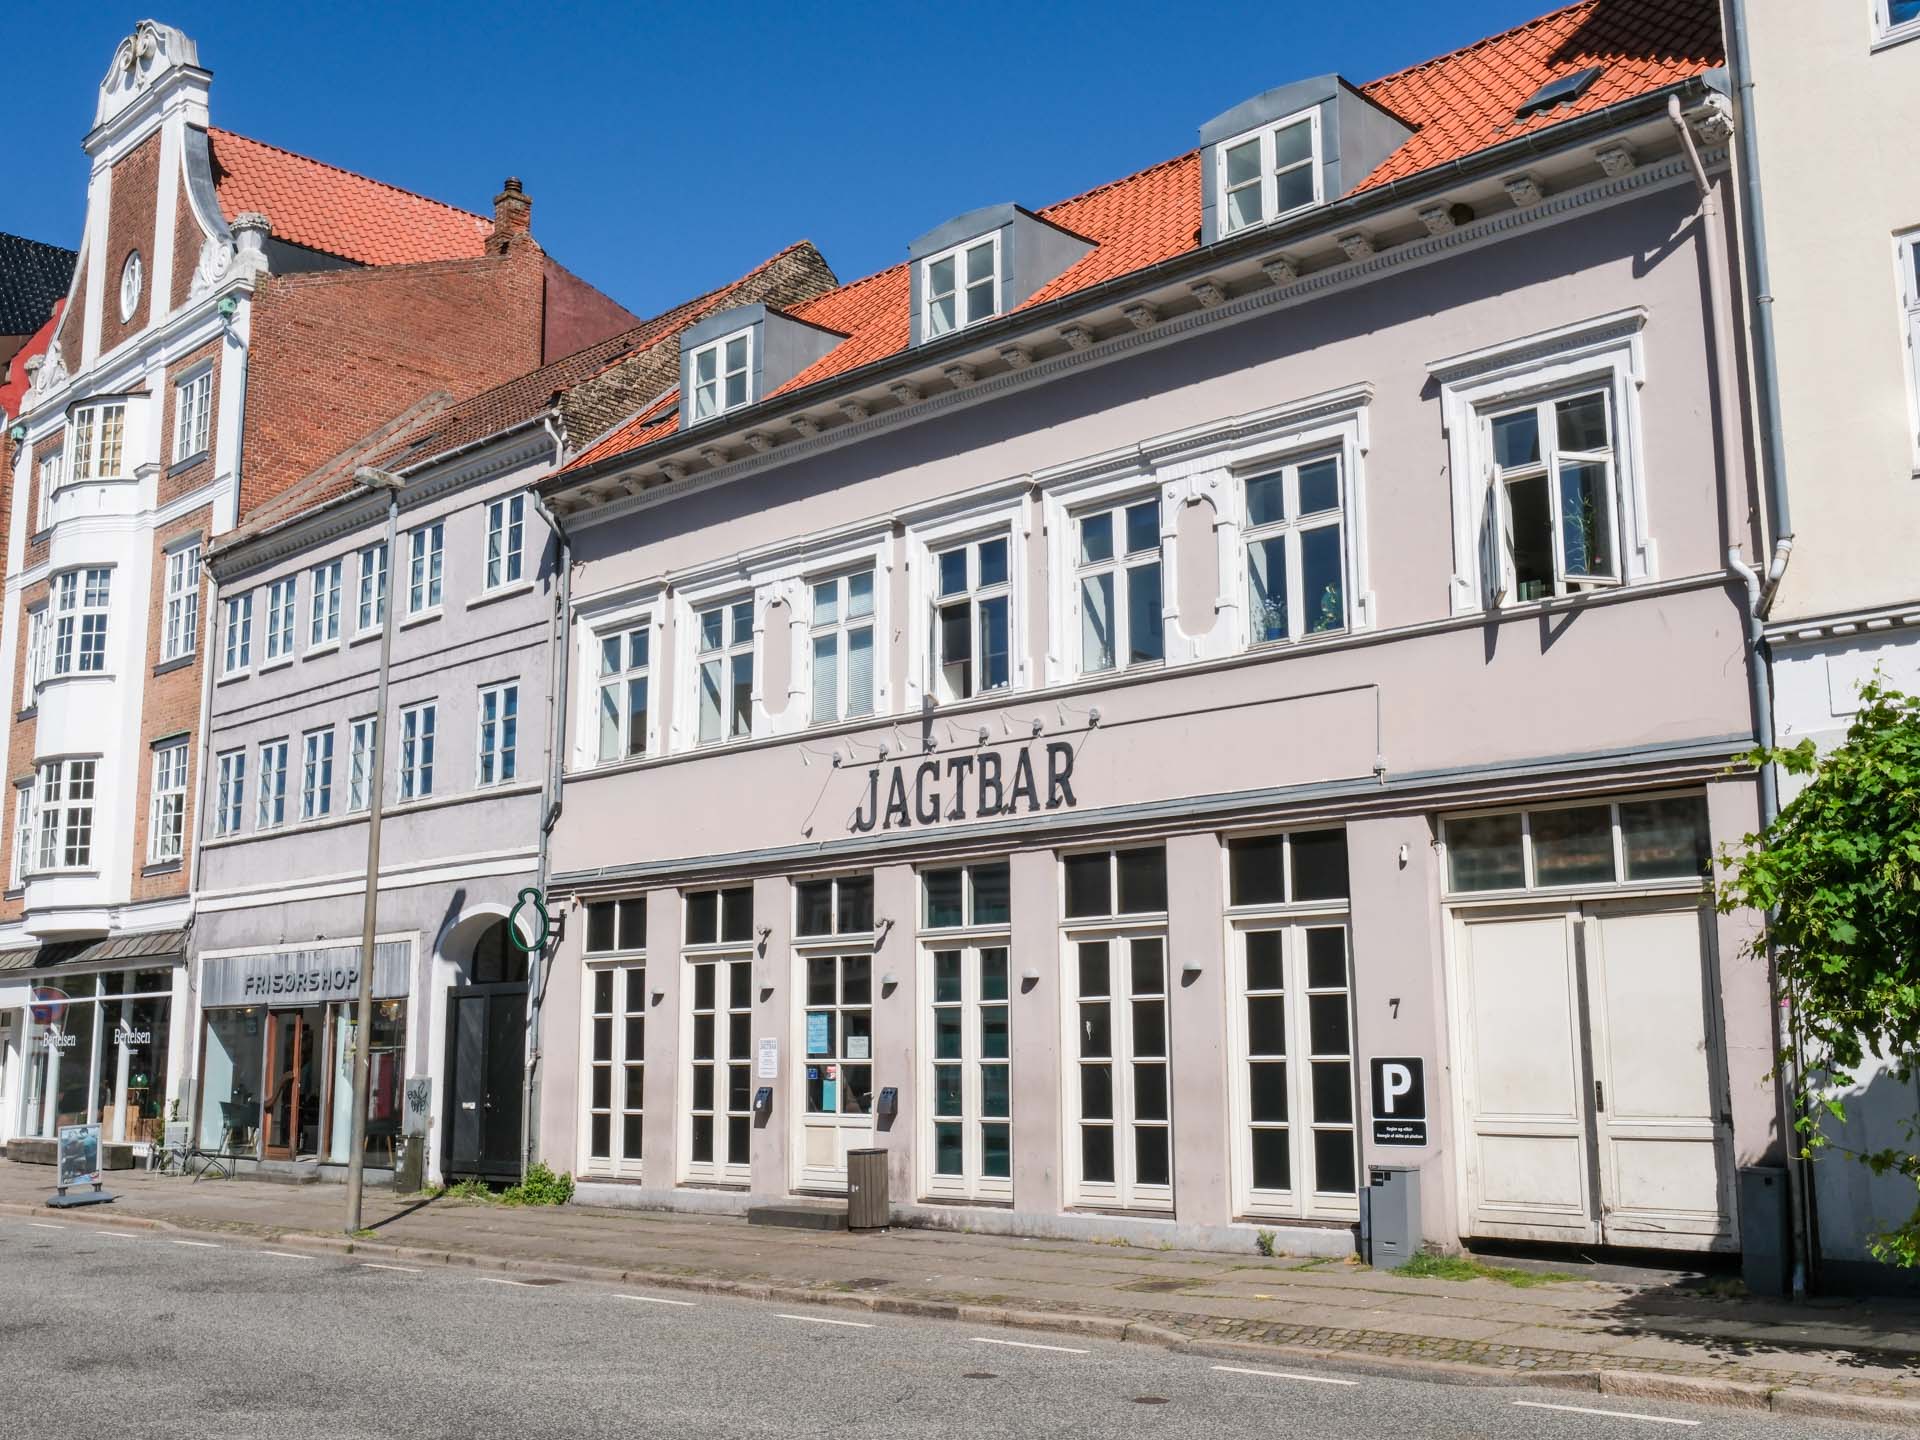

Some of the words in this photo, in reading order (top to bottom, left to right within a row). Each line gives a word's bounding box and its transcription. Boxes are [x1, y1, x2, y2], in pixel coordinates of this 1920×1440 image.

[856, 741, 1077, 833] JAGTBAR
[244, 967, 359, 996] FRISØRSHOP
[1389, 998, 1401, 1020] 7
[43, 1031, 76, 1047] Bertelsen
[114, 1027, 151, 1045] Bertelsen
[1382, 1063, 1412, 1113] P
